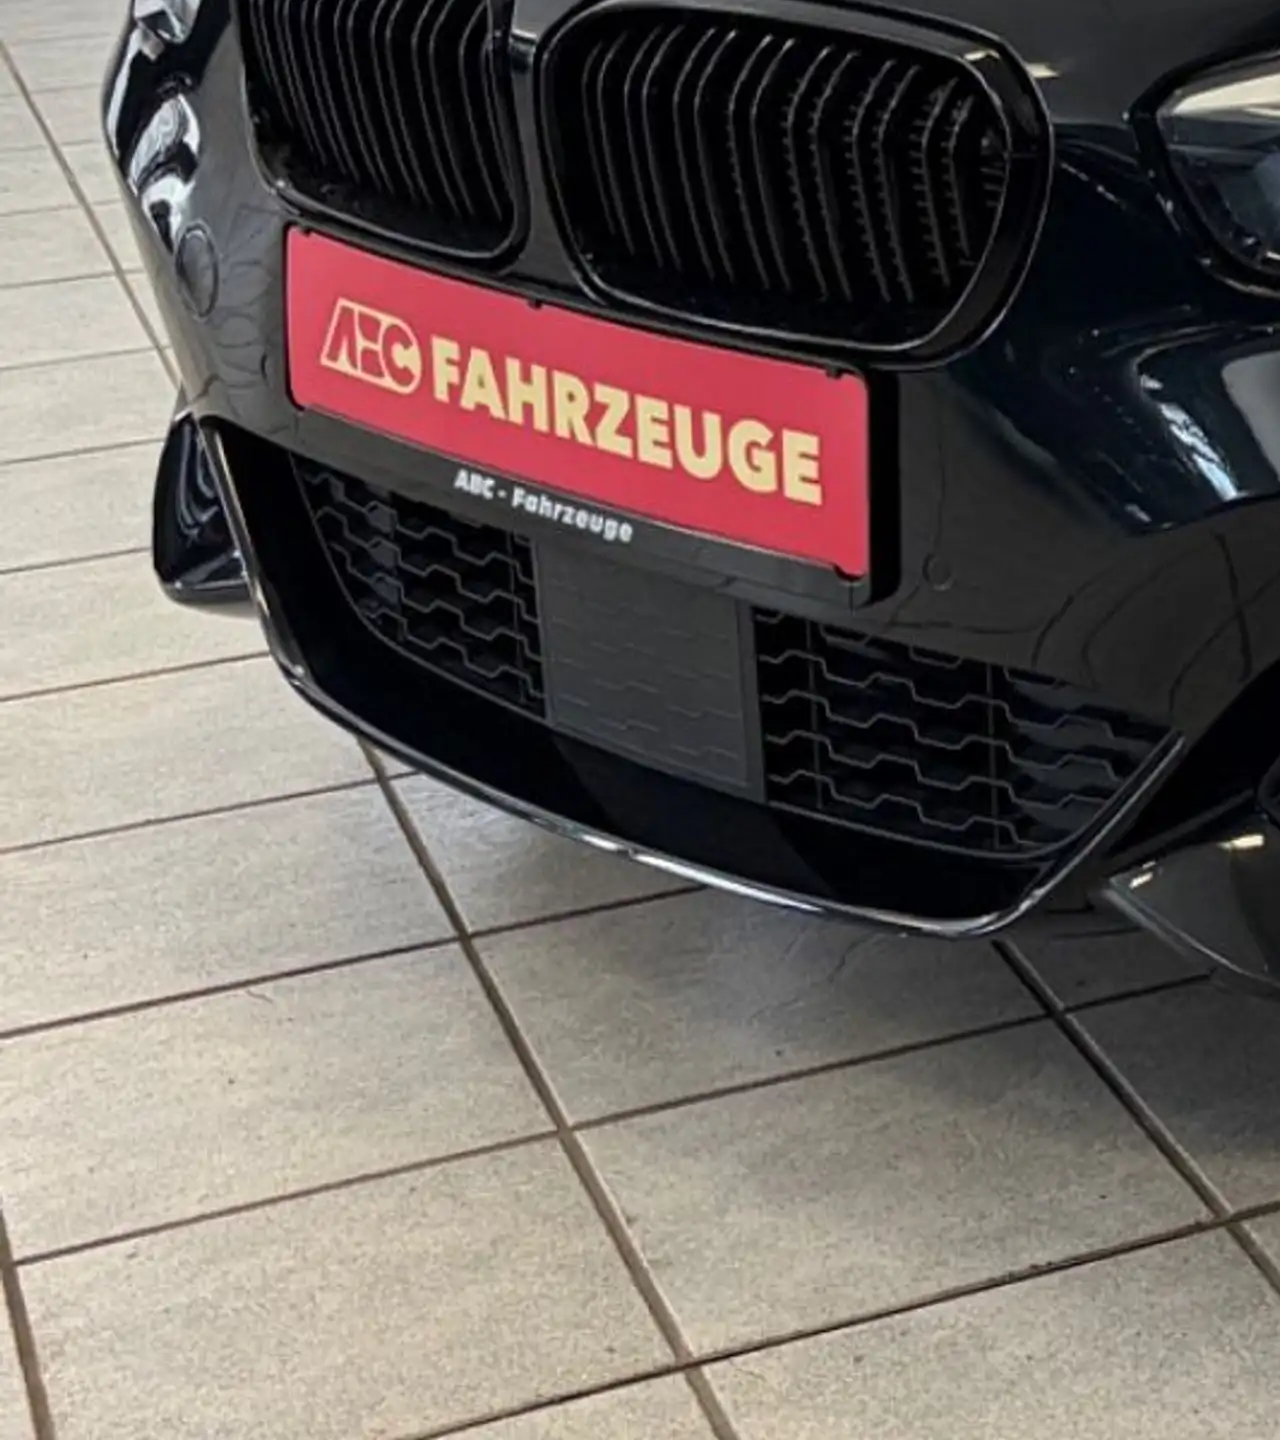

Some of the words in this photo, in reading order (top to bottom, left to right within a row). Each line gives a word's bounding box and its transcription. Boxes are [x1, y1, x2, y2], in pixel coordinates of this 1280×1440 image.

[430, 335, 823, 506] FAHRZEUGE
[454, 468, 496, 500] ABC
[511, 486, 633, 543] Fahrzeuge
